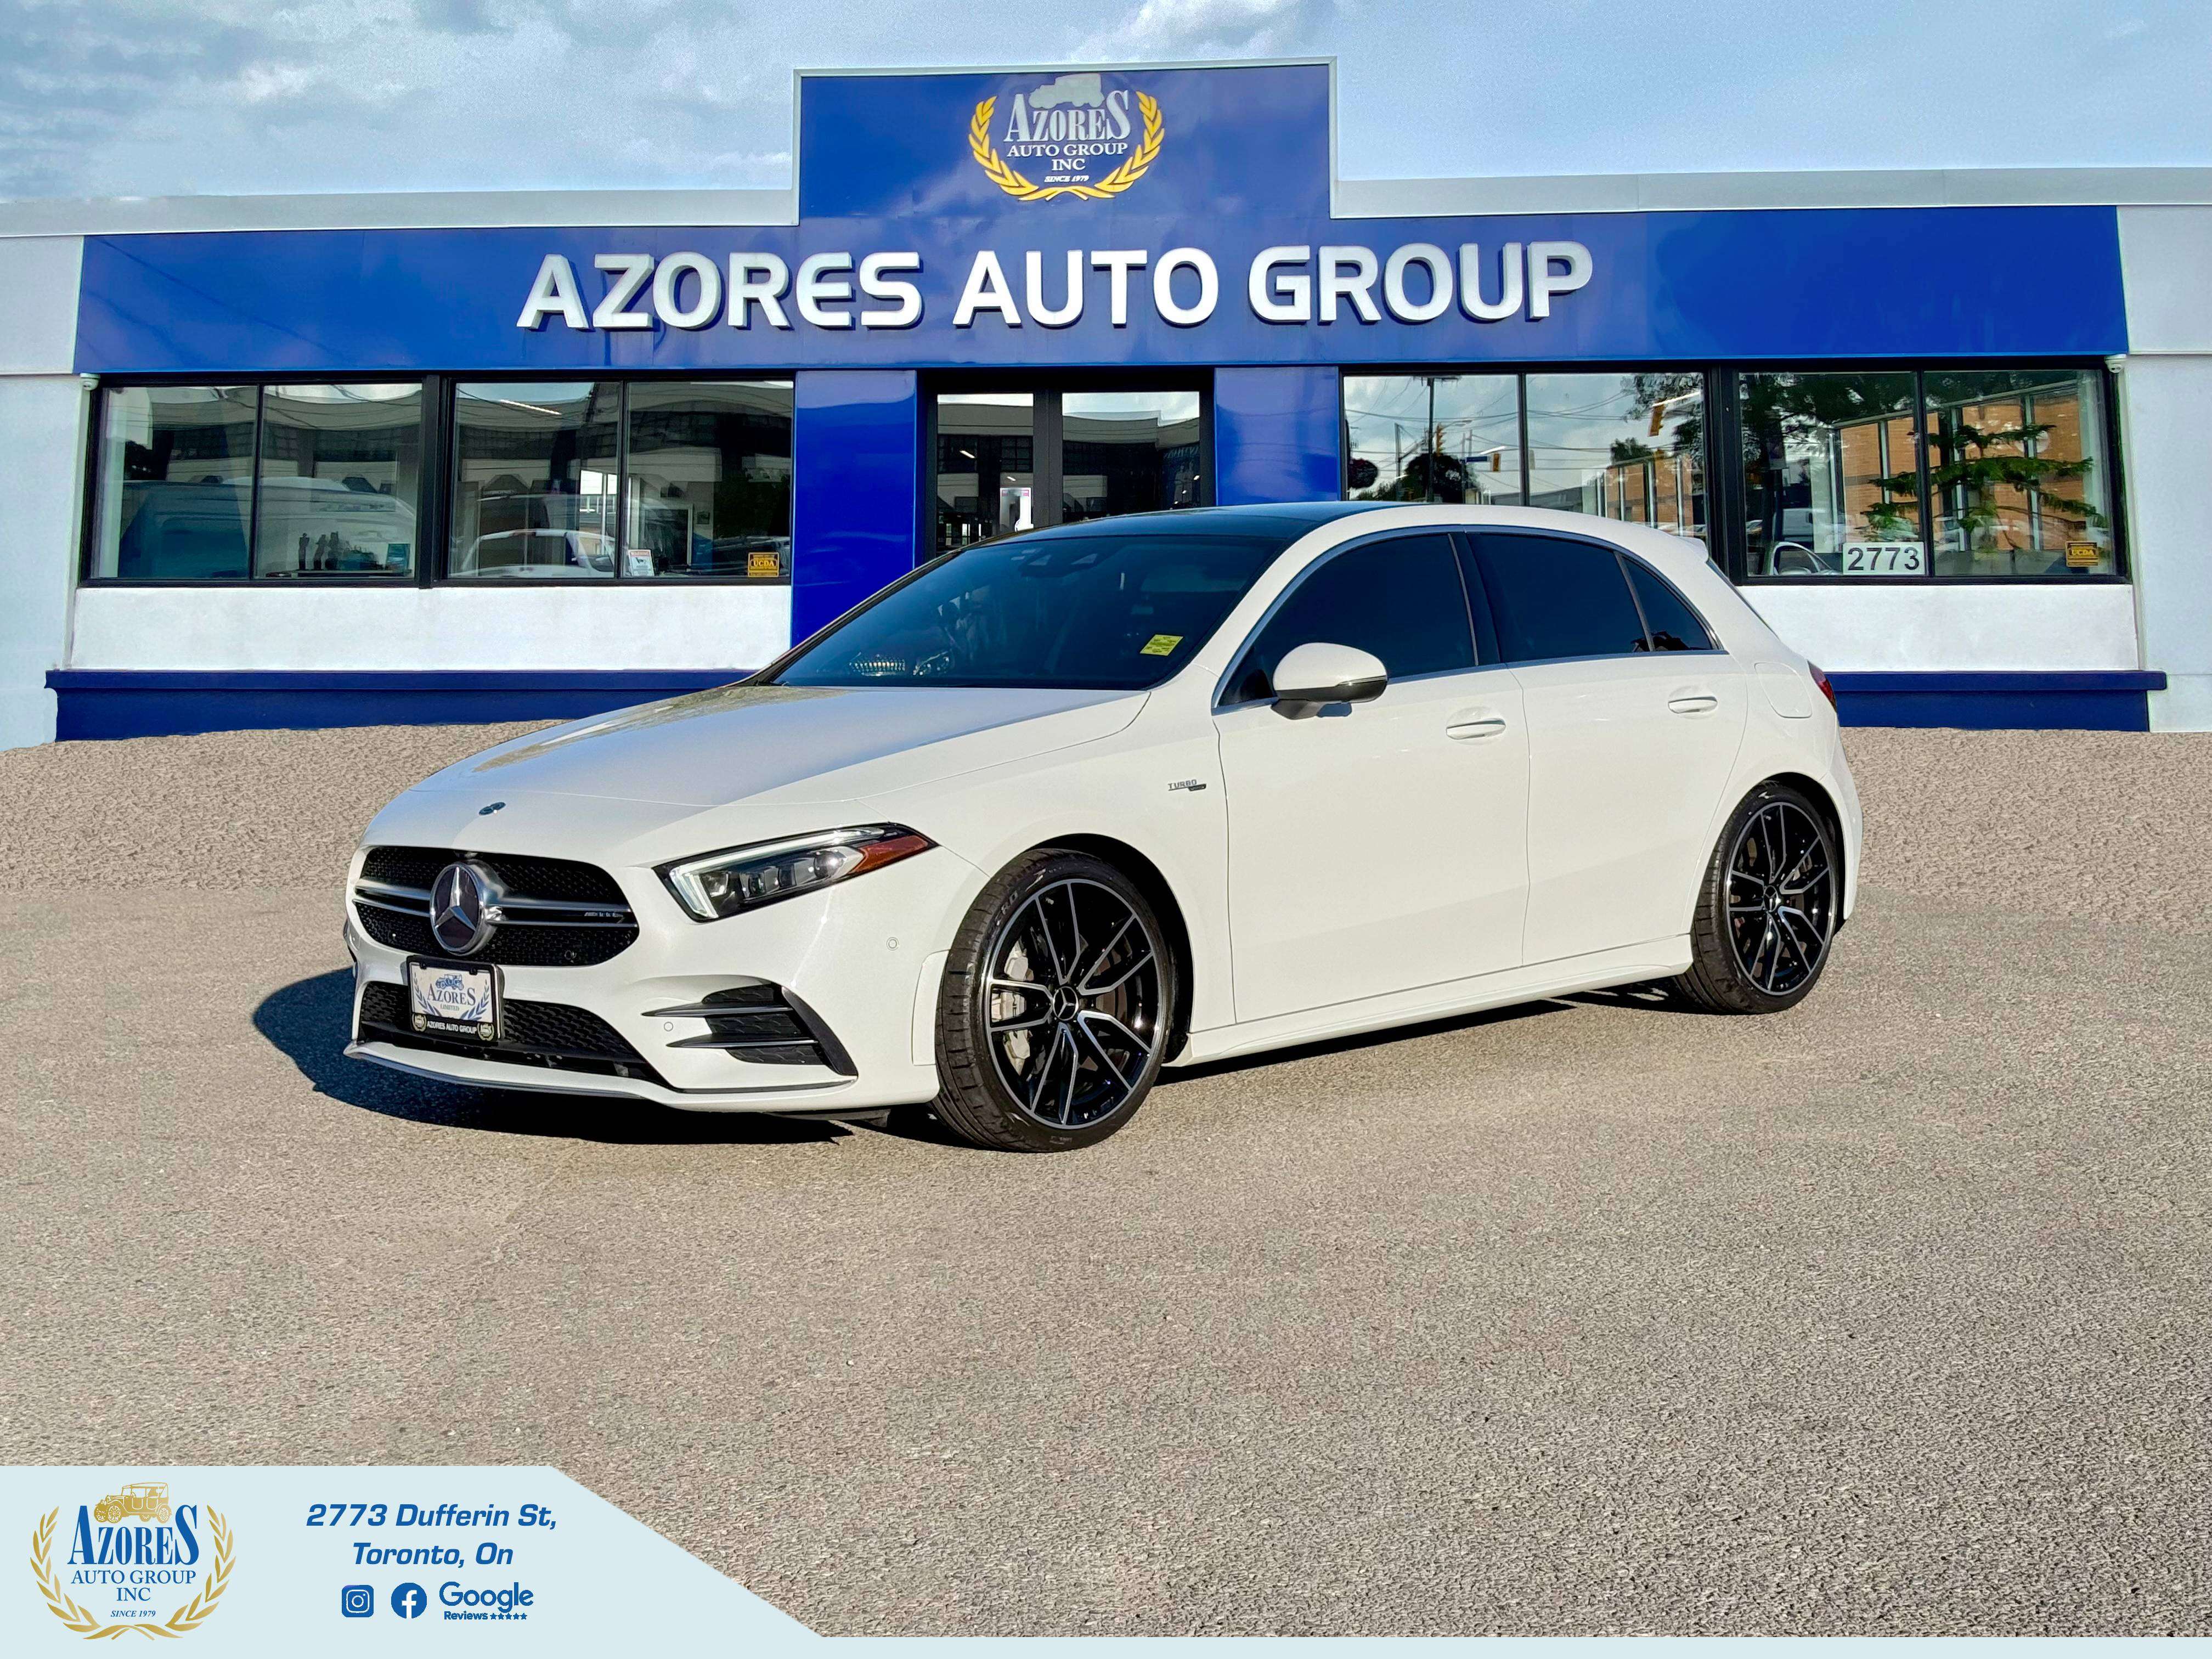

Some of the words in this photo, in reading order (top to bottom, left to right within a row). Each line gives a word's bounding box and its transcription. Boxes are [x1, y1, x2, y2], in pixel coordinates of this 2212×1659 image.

[1003, 90, 1131, 142] AZORES
[1007, 144, 1060, 157] AUTO
[1063, 143, 1128, 156] GROUP
[1051, 158, 1086, 171] INC
[516, 251, 922, 330] AZORES
[952, 248, 1219, 328] AUTO
[1248, 241, 1594, 323] GROUP
[1848, 547, 1920, 571] 2773
[1168, 780, 1197, 789] TURBO
[427, 983, 476, 1006] AZORES
[427, 1021, 445, 1030] AZORES
[445, 1023, 459, 1032] AUTO
[459, 1025, 477, 1034] GROUP
